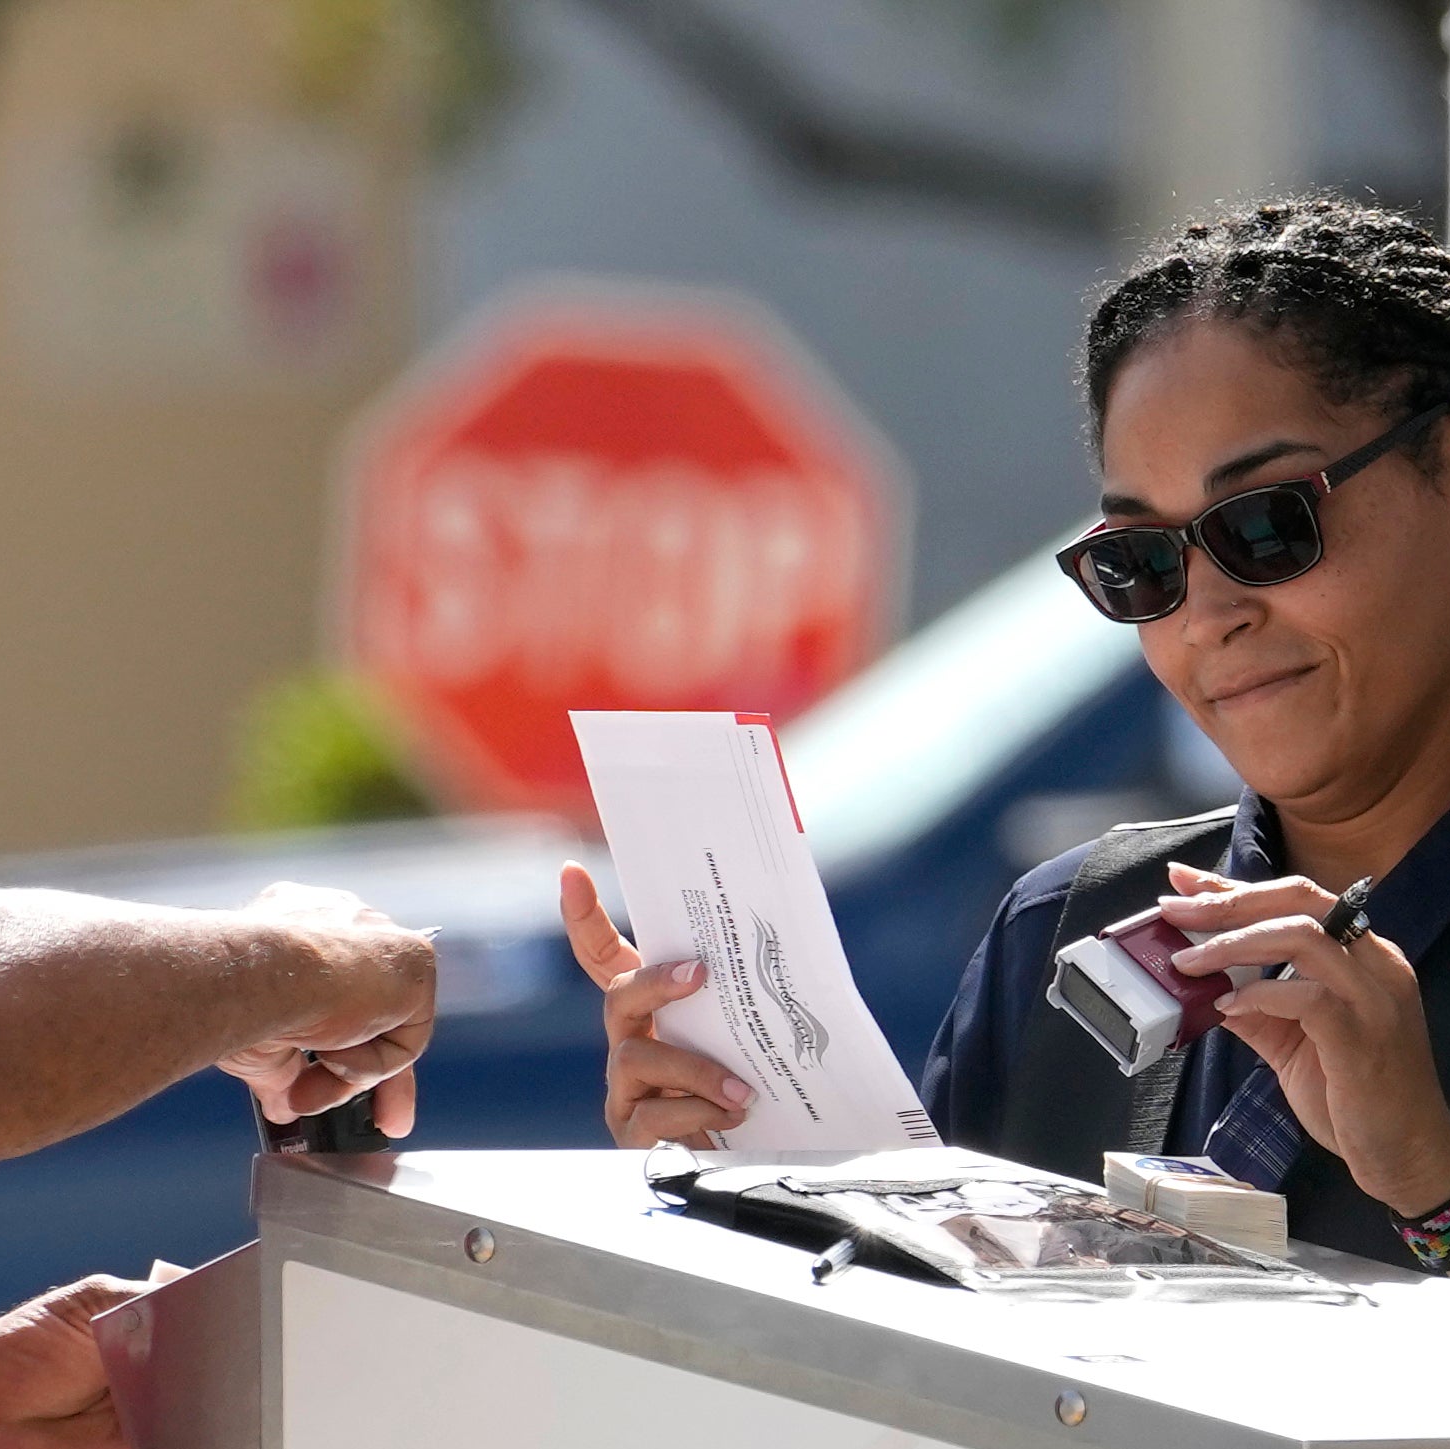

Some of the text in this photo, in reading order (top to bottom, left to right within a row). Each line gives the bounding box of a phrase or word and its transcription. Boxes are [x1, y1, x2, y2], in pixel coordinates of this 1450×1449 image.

[386, 455, 851, 695] STOP
[700, 890, 720, 953] SUPERVISOR
[718, 971, 741, 1028] ELECTIONS
[705, 851, 723, 890] OFFICIAL
[718, 892, 742, 955] VOTE-BY-MAIL
[736, 957, 755, 1007] BALLOTING
[708, 950, 722, 993] COUNTY
[717, 993, 742, 1048] ELECTIONS
